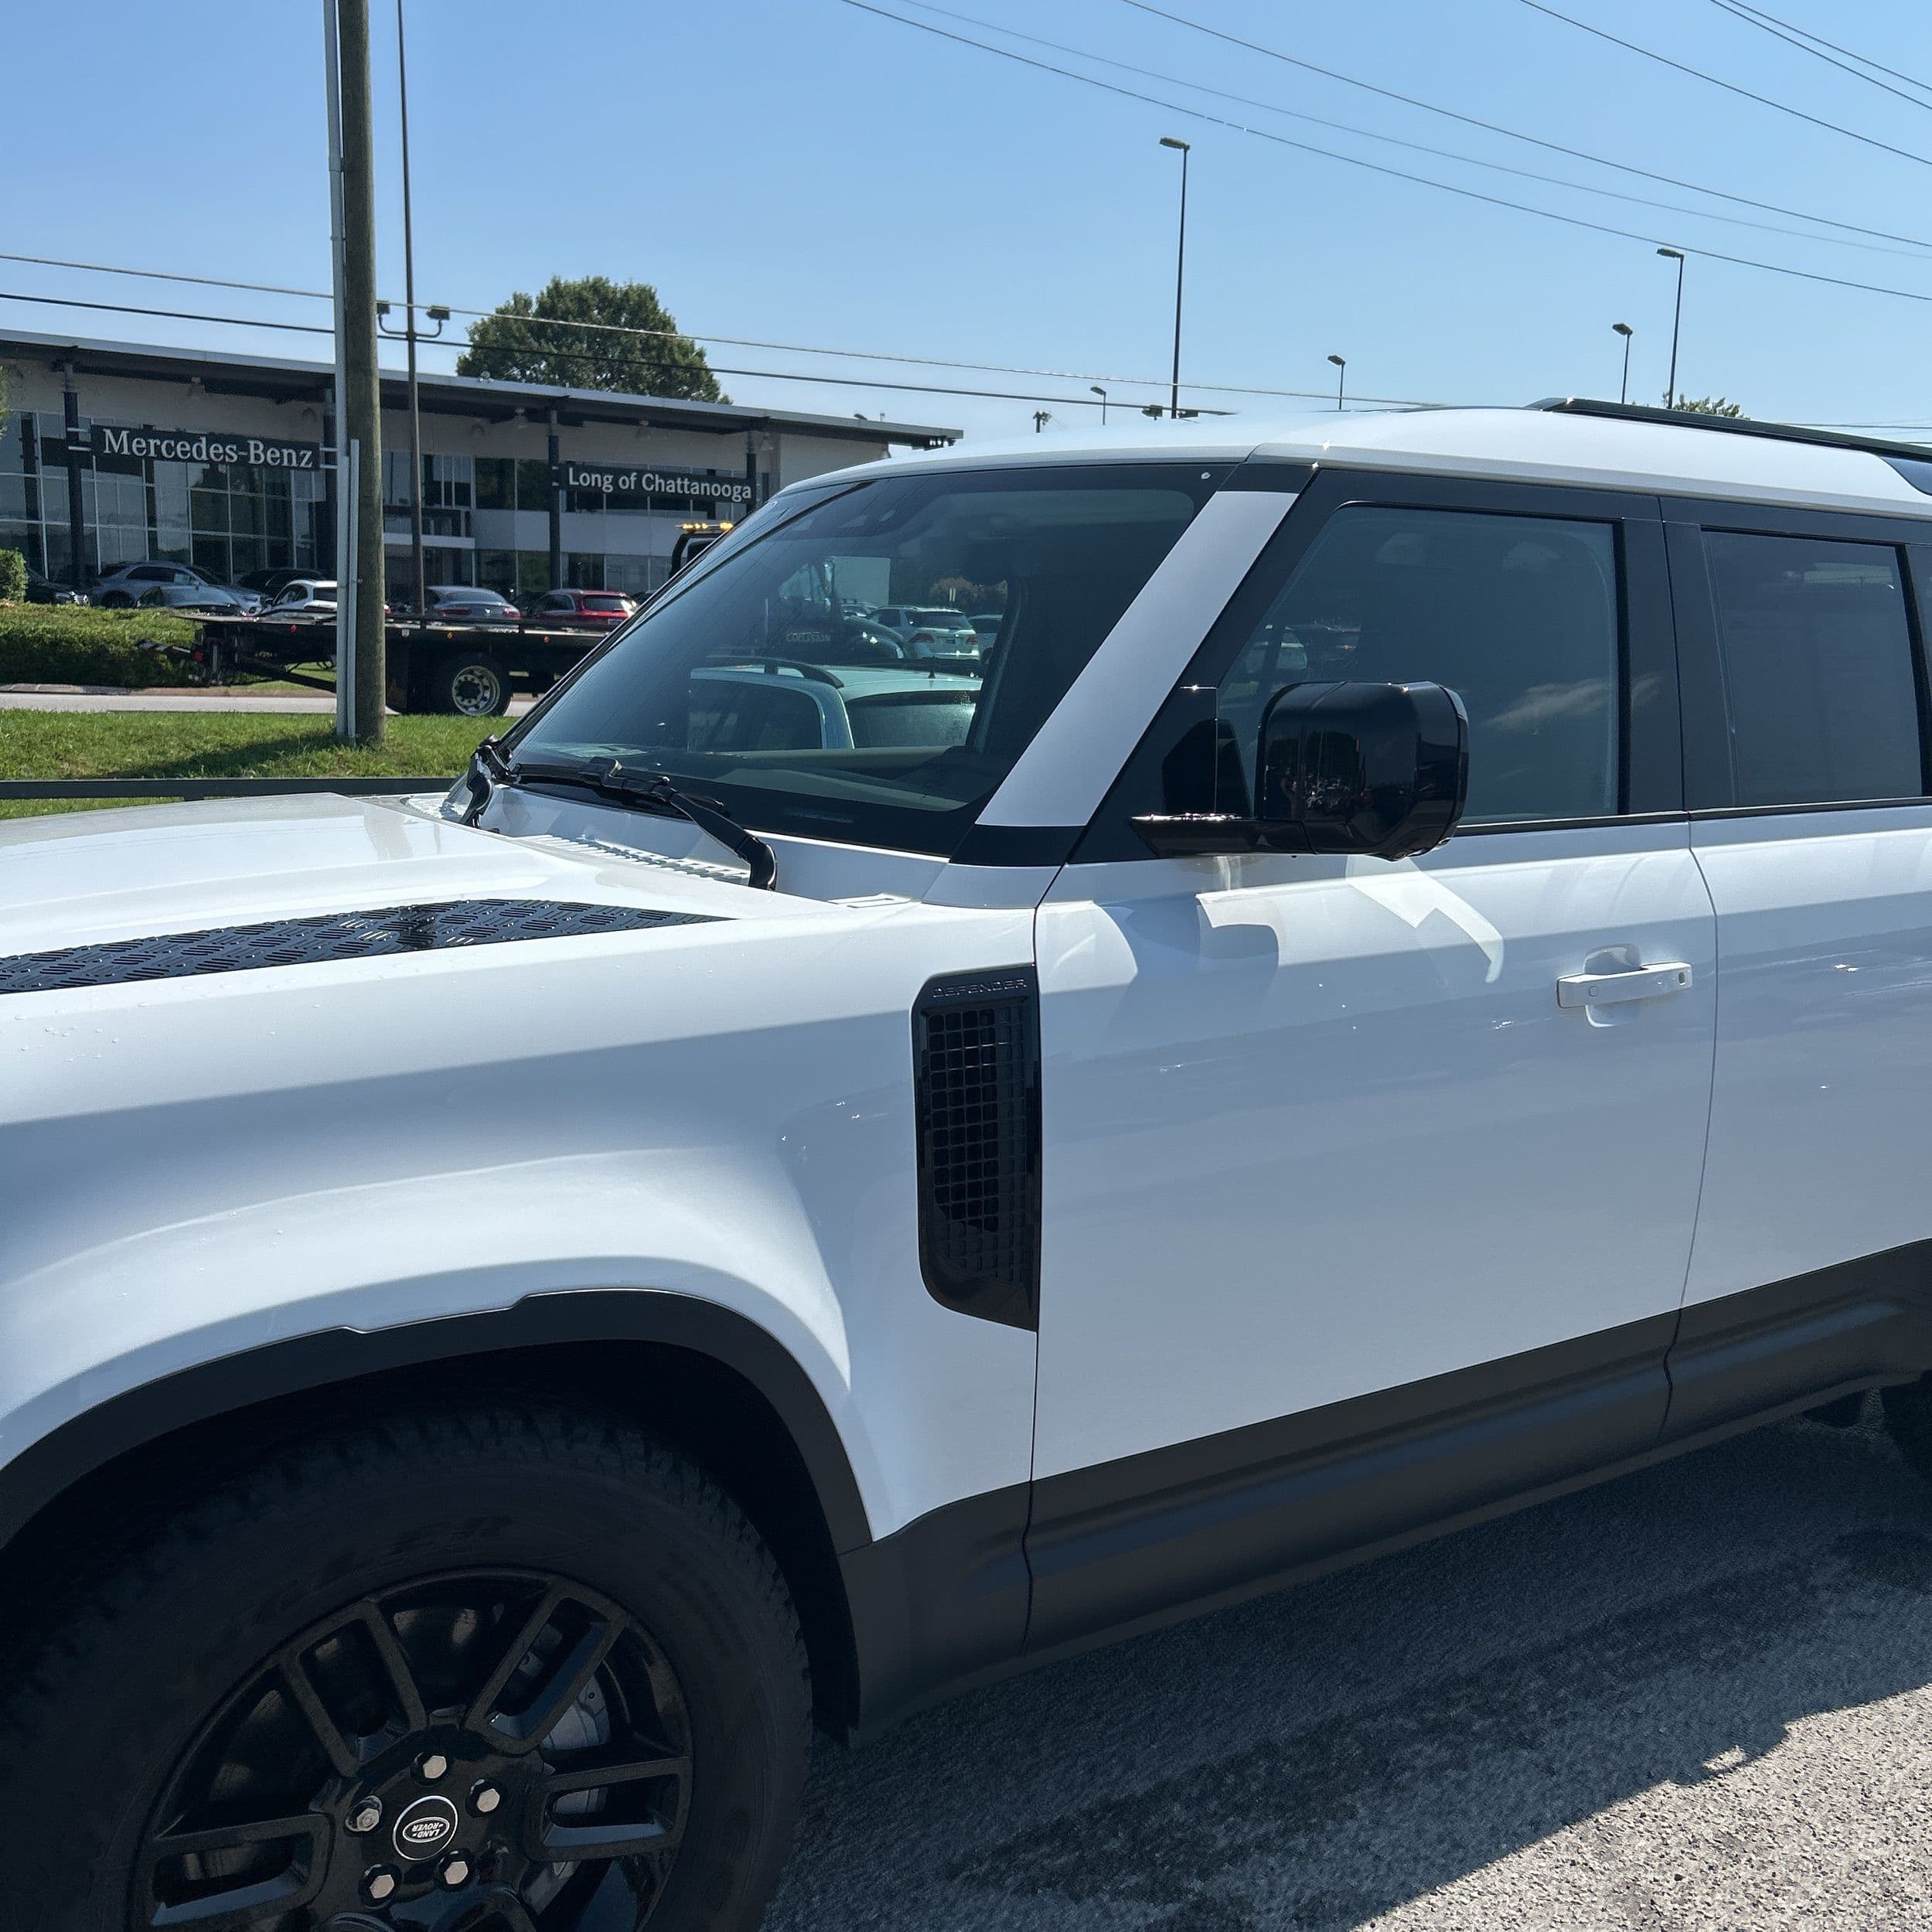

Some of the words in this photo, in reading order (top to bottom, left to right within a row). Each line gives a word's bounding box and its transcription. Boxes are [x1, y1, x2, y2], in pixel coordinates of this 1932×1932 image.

[103, 428, 313, 469] Mercedes-Benz
[568, 467, 614, 492] Long
[618, 472, 638, 490] of
[642, 473, 752, 503] Chattanooga
[932, 979, 1027, 998] DEFENDER
